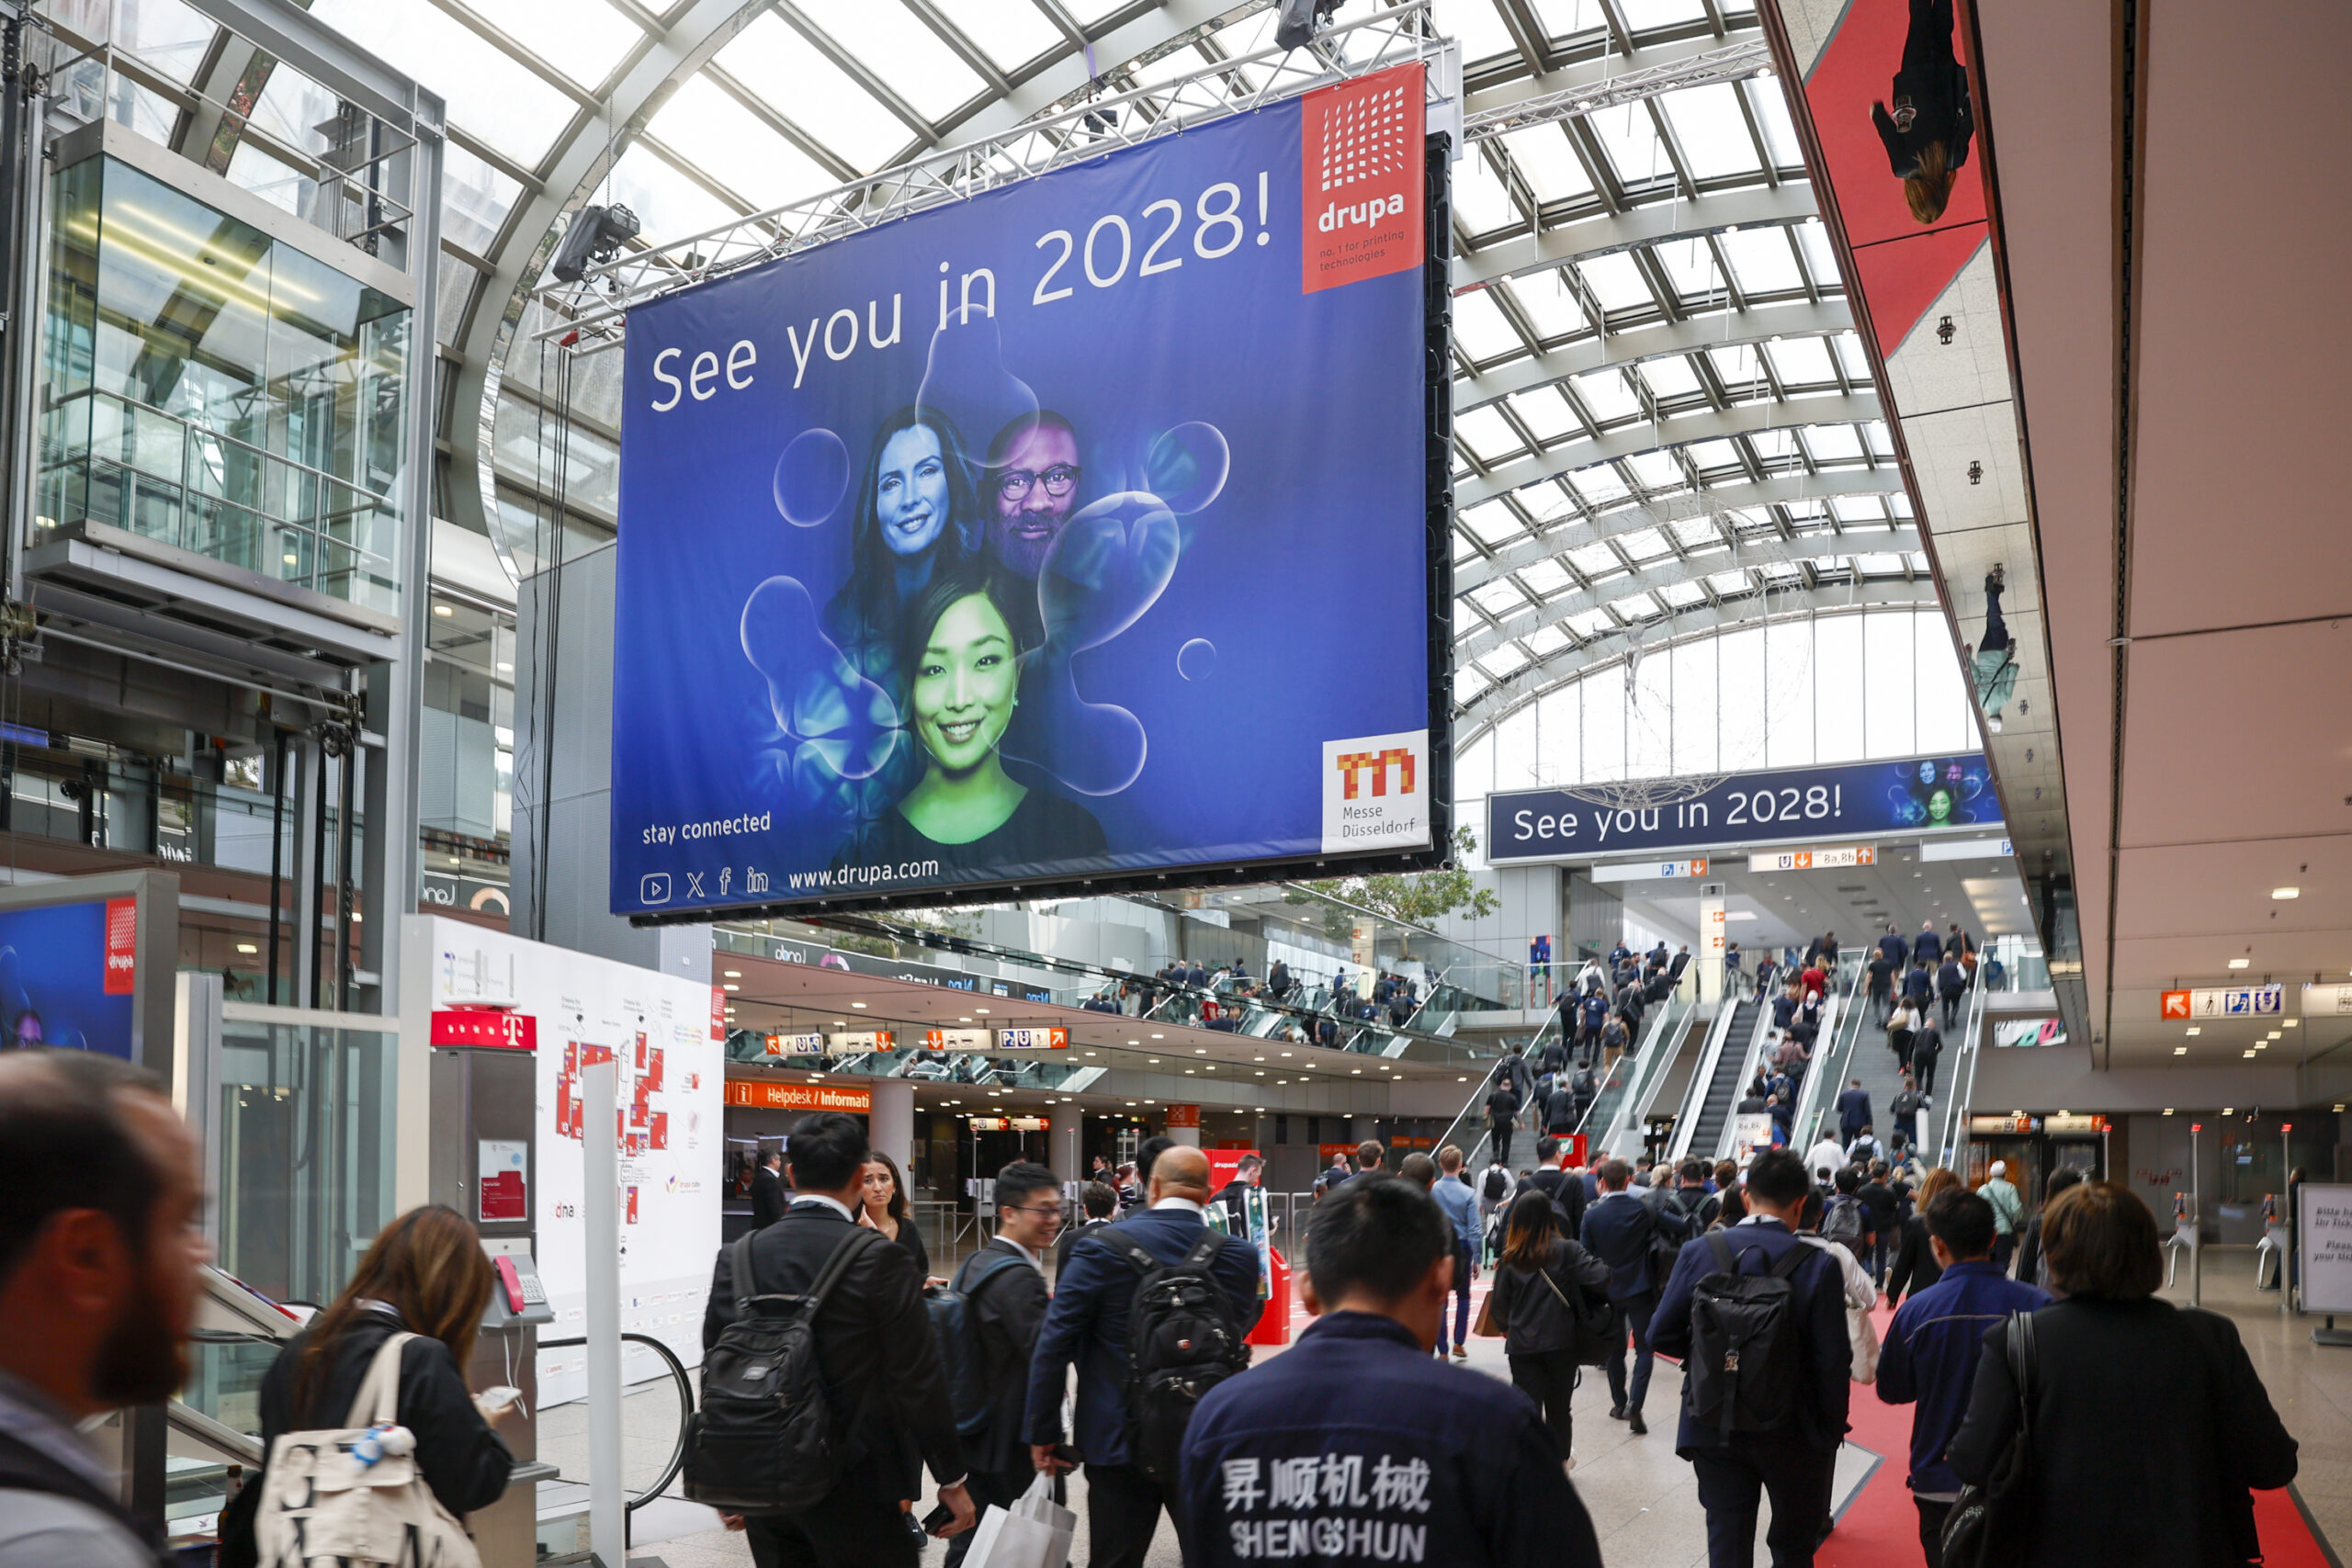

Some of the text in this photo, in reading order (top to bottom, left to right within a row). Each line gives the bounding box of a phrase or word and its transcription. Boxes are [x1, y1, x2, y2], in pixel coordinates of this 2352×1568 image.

[1317, 193, 1405, 233] drupa
[1319, 246, 1335, 258] no.
[1345, 241, 1360, 253] for
[1363, 231, 1405, 249] printing
[1319, 248, 1386, 272] technologies
[650, 171, 1272, 413] See you in 2028!
[1342, 806, 1383, 819] Messe
[1513, 783, 1843, 842] See you in 2028!
[642, 810, 772, 846] stay connected
[1342, 818, 1416, 838] Düsseldorf
[1824, 852, 1855, 865] 8a,8b
[788, 858, 940, 891] www.drupa.com
[108, 952, 134, 972] drupa
[767, 1087, 812, 1107] Helpdesk
[820, 1091, 870, 1109] Informati
[2315, 1206, 2340, 1216] Bitte
[2333, 1218, 2352, 1228] Tick
[2313, 1252, 2335, 1263] your
[1228, 1516, 1428, 1564] SHENGSHUN
